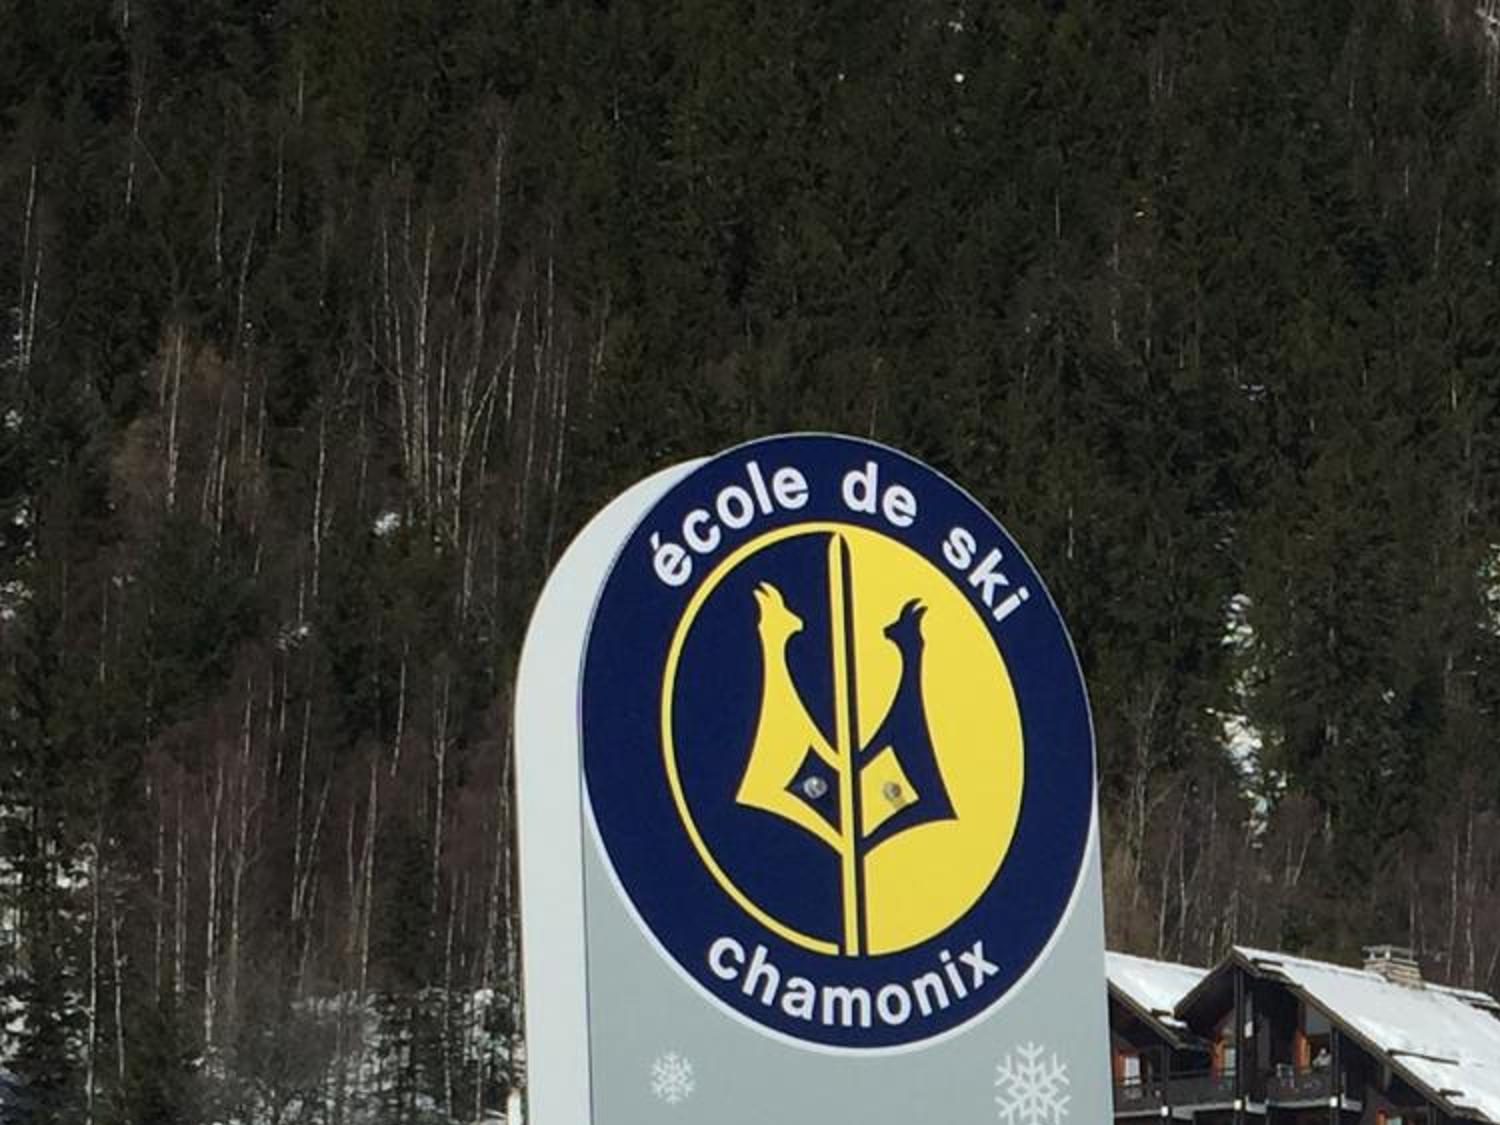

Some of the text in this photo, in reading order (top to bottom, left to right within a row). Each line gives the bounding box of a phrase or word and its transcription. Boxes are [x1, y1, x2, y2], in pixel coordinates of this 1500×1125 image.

[652, 461, 1029, 622] école de ski
[708, 936, 999, 1027] chamonix
